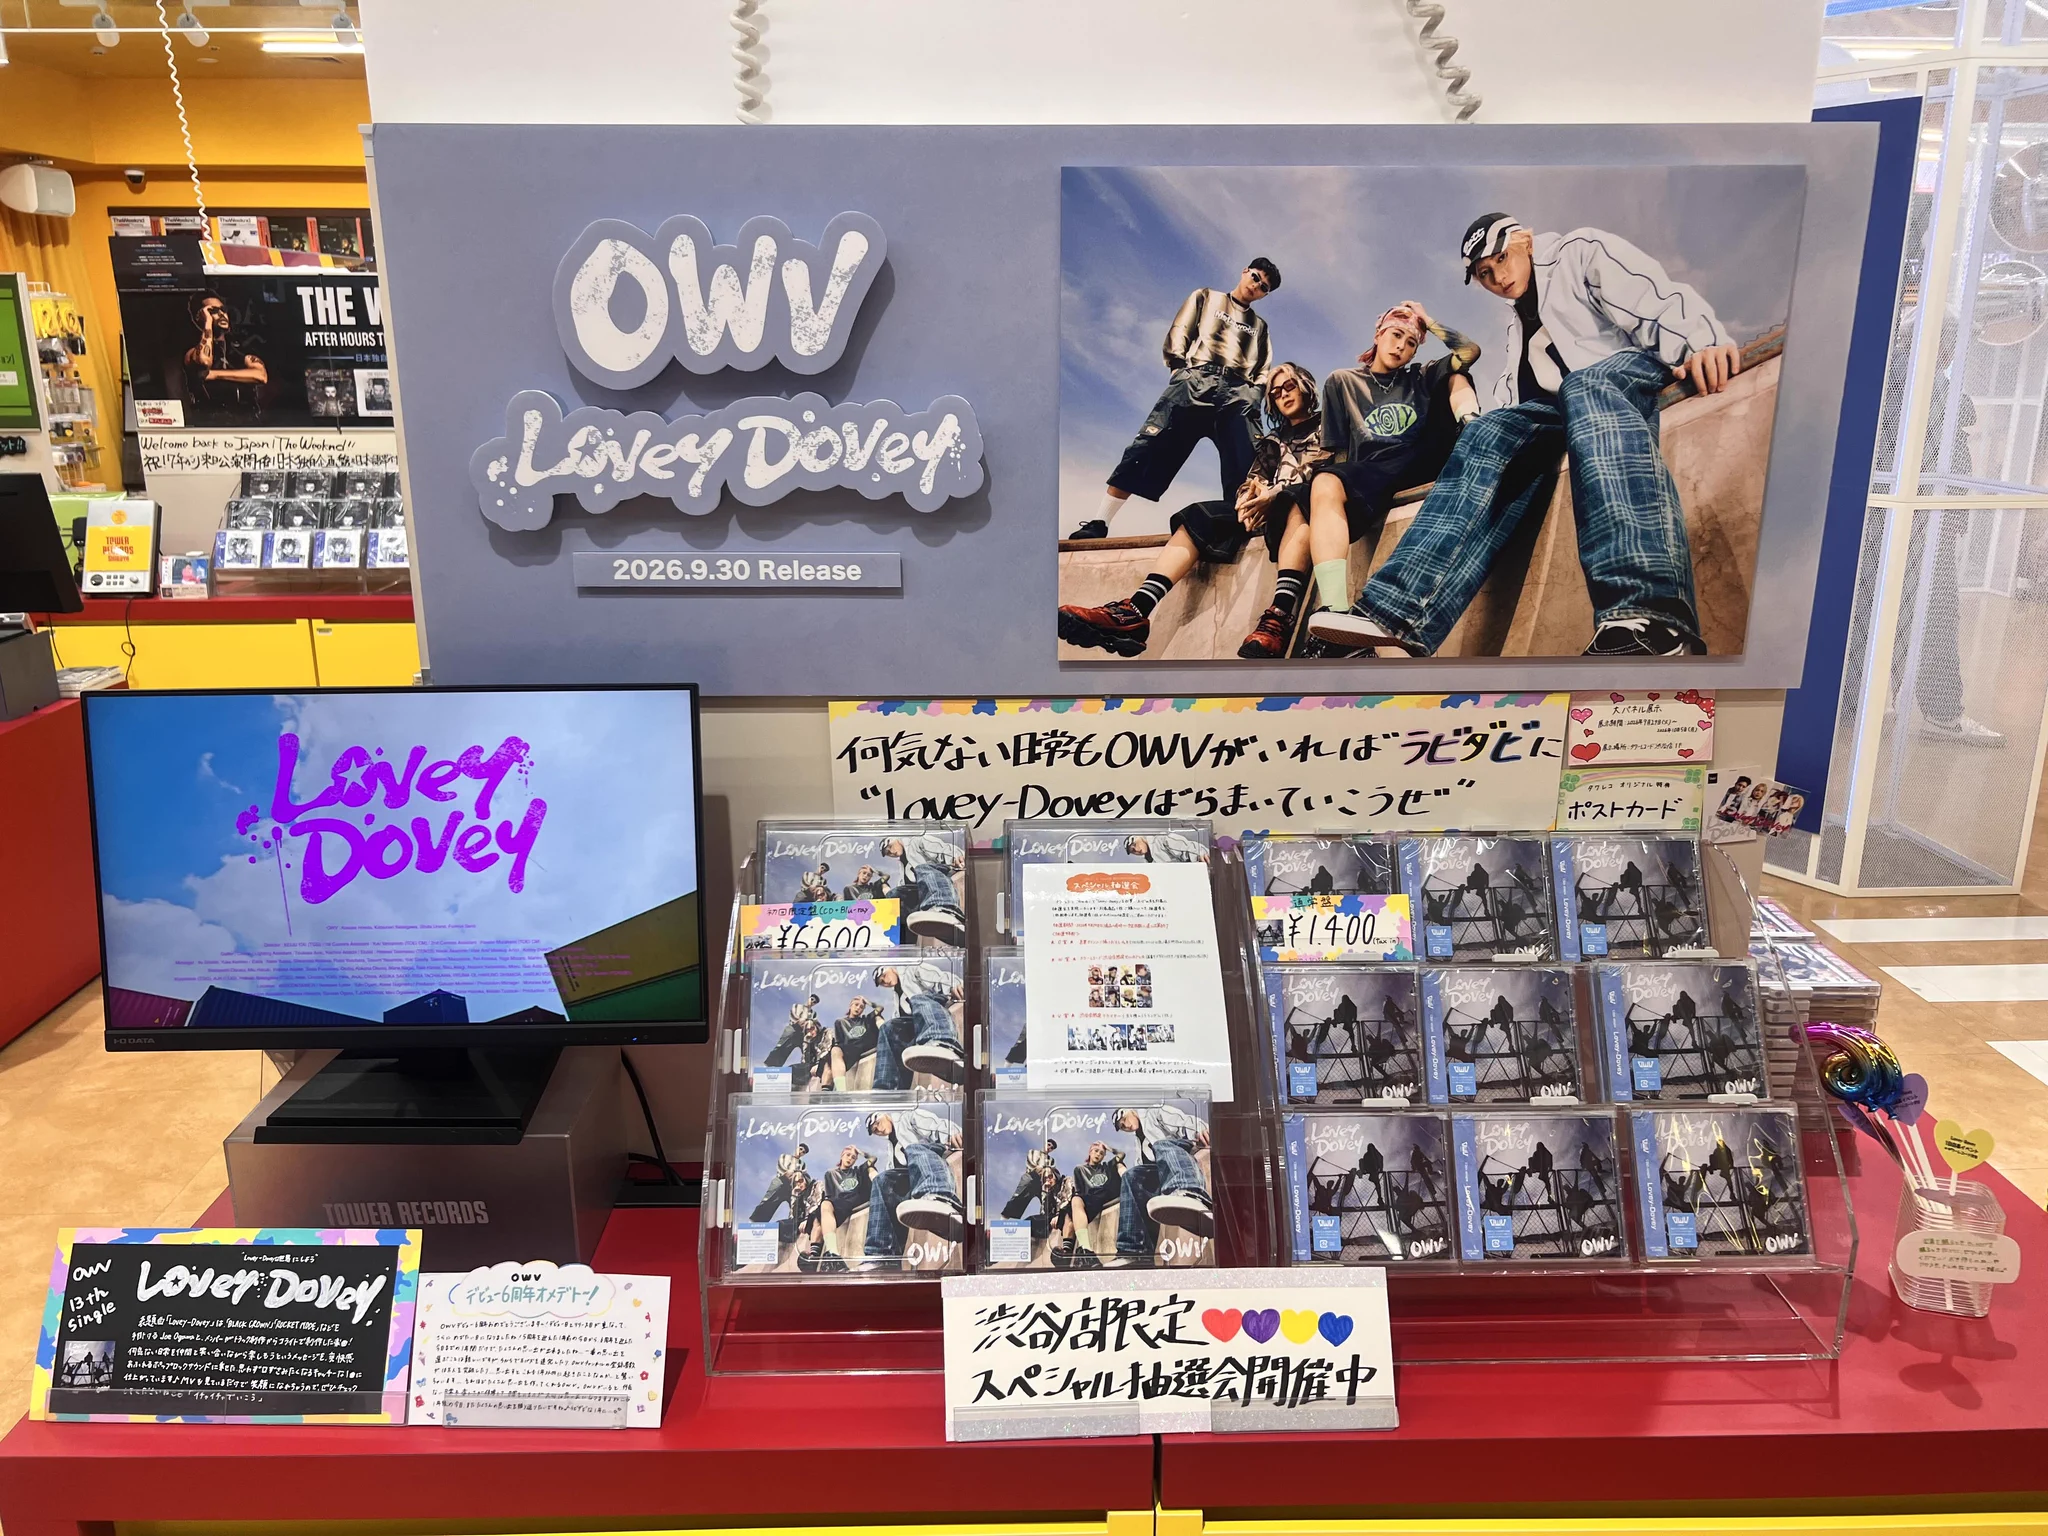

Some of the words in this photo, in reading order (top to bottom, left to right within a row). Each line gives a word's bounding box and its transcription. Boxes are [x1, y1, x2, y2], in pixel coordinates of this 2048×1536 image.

[296, 286, 356, 325] THE
[570, 230, 869, 372] OWV
[305, 331, 338, 346] AFTER
[340, 331, 376, 346] HOURS
[140, 437, 189, 450] Welcome
[192, 436, 218, 450] back
[224, 440, 233, 449] to
[514, 408, 734, 498] Lovey
[737, 409, 960, 495] Dovey
[106, 536, 130, 545] TOWER
[612, 559, 751, 583] 2026.9.30
[758, 559, 862, 582] Release
[1611, 704, 1662, 716] 大パネル展示
[270, 732, 530, 824] Lovey
[1587, 783, 1614, 792] タワレコ
[1619, 781, 1653, 789] オリジナル
[1655, 781, 1671, 789] 特典
[1568, 797, 1684, 820] ポストカード
[290, 798, 548, 904] Dovey
[825, 836, 875, 859] Dovey
[1068, 836, 1119, 857] Dovey
[1272, 859, 1317, 877] Dovey
[1579, 854, 1626, 873] Dovey
[1293, 896, 1334, 909] 通常盤
[1564, 898, 1572, 940] Lovey-Dovey
[814, 965, 868, 990] Dovey
[1288, 975, 1337, 992] Lovey
[1444, 976, 1492, 993] Lovey
[1626, 971, 1673, 989] Lovey
[1291, 988, 1340, 1006] Dovey
[1447, 988, 1496, 1006] Dovey
[1628, 984, 1677, 1004] Dovey
[1431, 1035, 1440, 1081] Lovey-Dovey
[1613, 1031, 1623, 1077] Lovey-Dovey
[1381, 1082, 1414, 1099] OWV
[1540, 1081, 1572, 1097] OWV
[1724, 1077, 1757, 1094] OWV
[802, 1112, 863, 1138] Dovey
[1049, 1112, 1107, 1136] Dovey
[1310, 1122, 1361, 1140] Lovey
[1315, 1136, 1365, 1158] Dovey
[1482, 1135, 1534, 1157] Dovey
[322, 1202, 396, 1226] TOWER
[399, 1201, 489, 1225] RECORDS
[1293, 1185, 1302, 1234] Lovey-Dovey
[1647, 1182, 1657, 1230] Lovey-Dovey
[907, 1239, 957, 1266] OWV
[1159, 1236, 1210, 1263] OWV
[1409, 1236, 1444, 1258] OWV
[1580, 1235, 1615, 1256] OWV
[1765, 1232, 1799, 1253] OWV
[511, 1272, 542, 1283] OWV
[68, 1286, 110, 1313] 13th
[136, 1260, 261, 1308] Lovey
[264, 1267, 388, 1325] Dovey
[67, 1299, 117, 1333] Single
[972, 1293, 1211, 1354] 渋谷店限定
[971, 1354, 1378, 1408] スペシャル抽選会開催中
